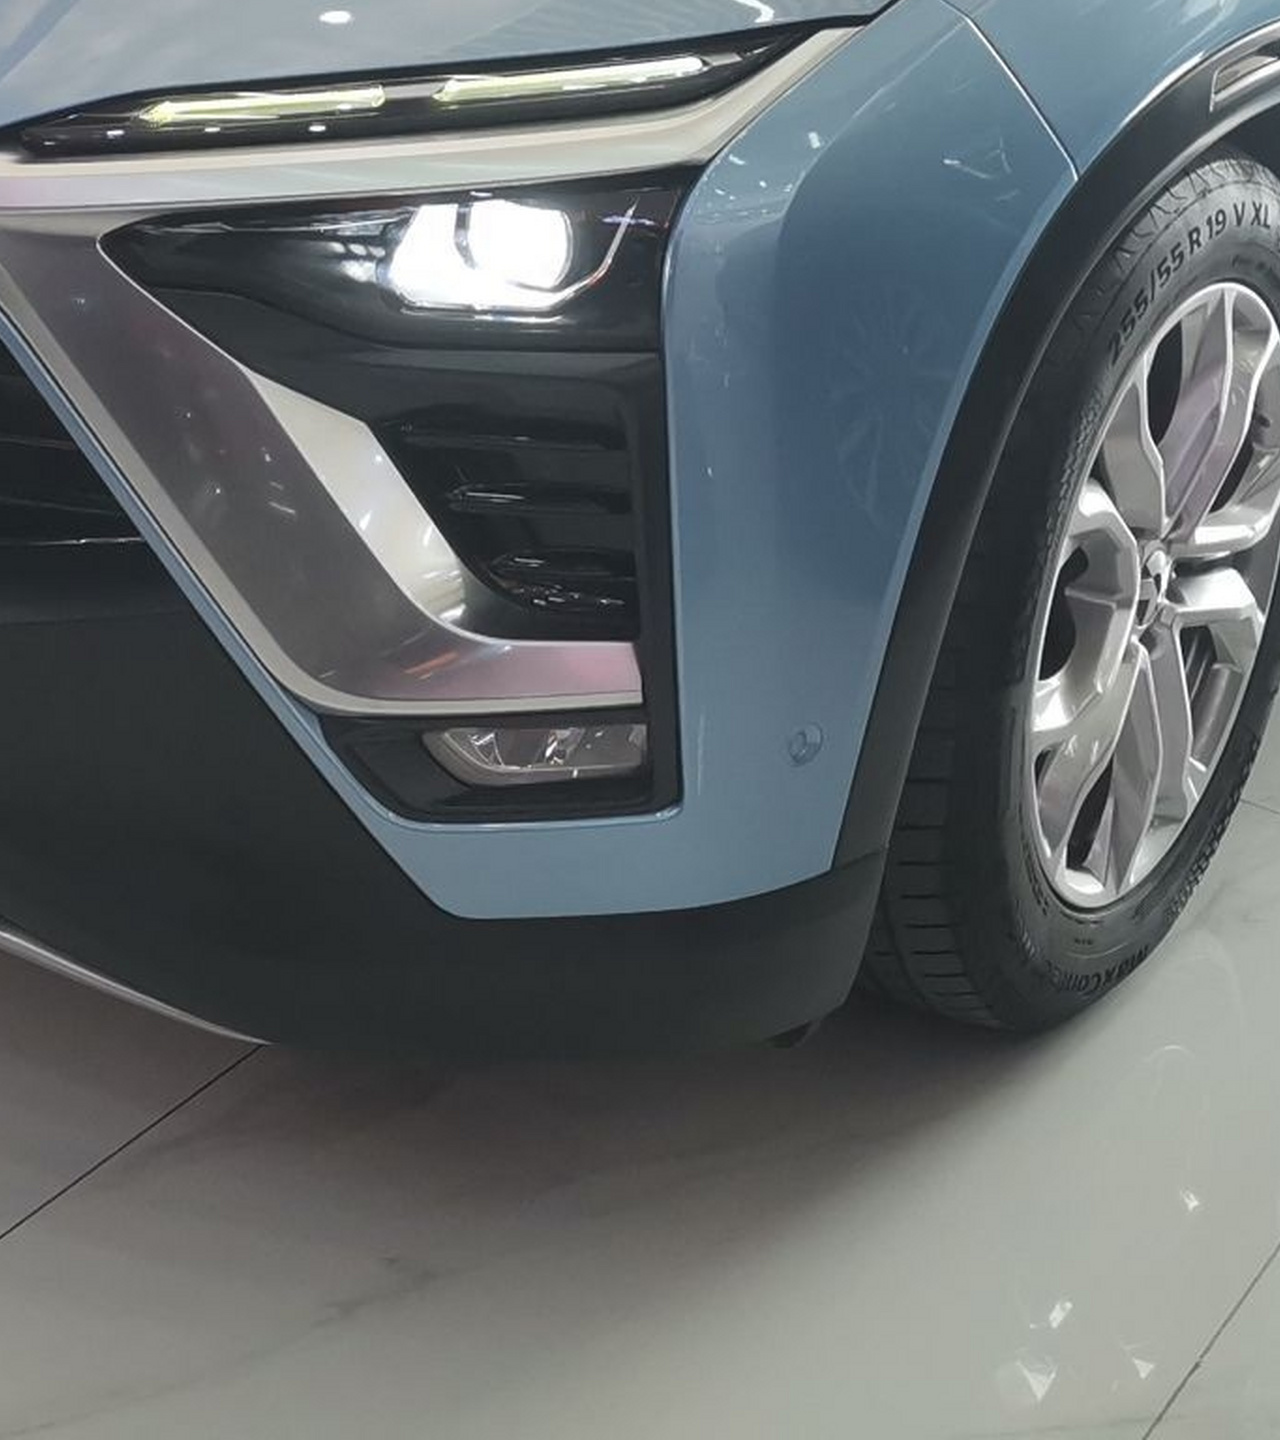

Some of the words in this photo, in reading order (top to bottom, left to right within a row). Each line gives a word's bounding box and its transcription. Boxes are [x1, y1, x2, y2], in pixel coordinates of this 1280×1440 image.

[1107, 241, 1186, 366] 255/55
[1187, 226, 1202, 256] R
[1206, 209, 1227, 240] 19
[1233, 201, 1246, 227] V
[1251, 201, 1271, 228] XL
